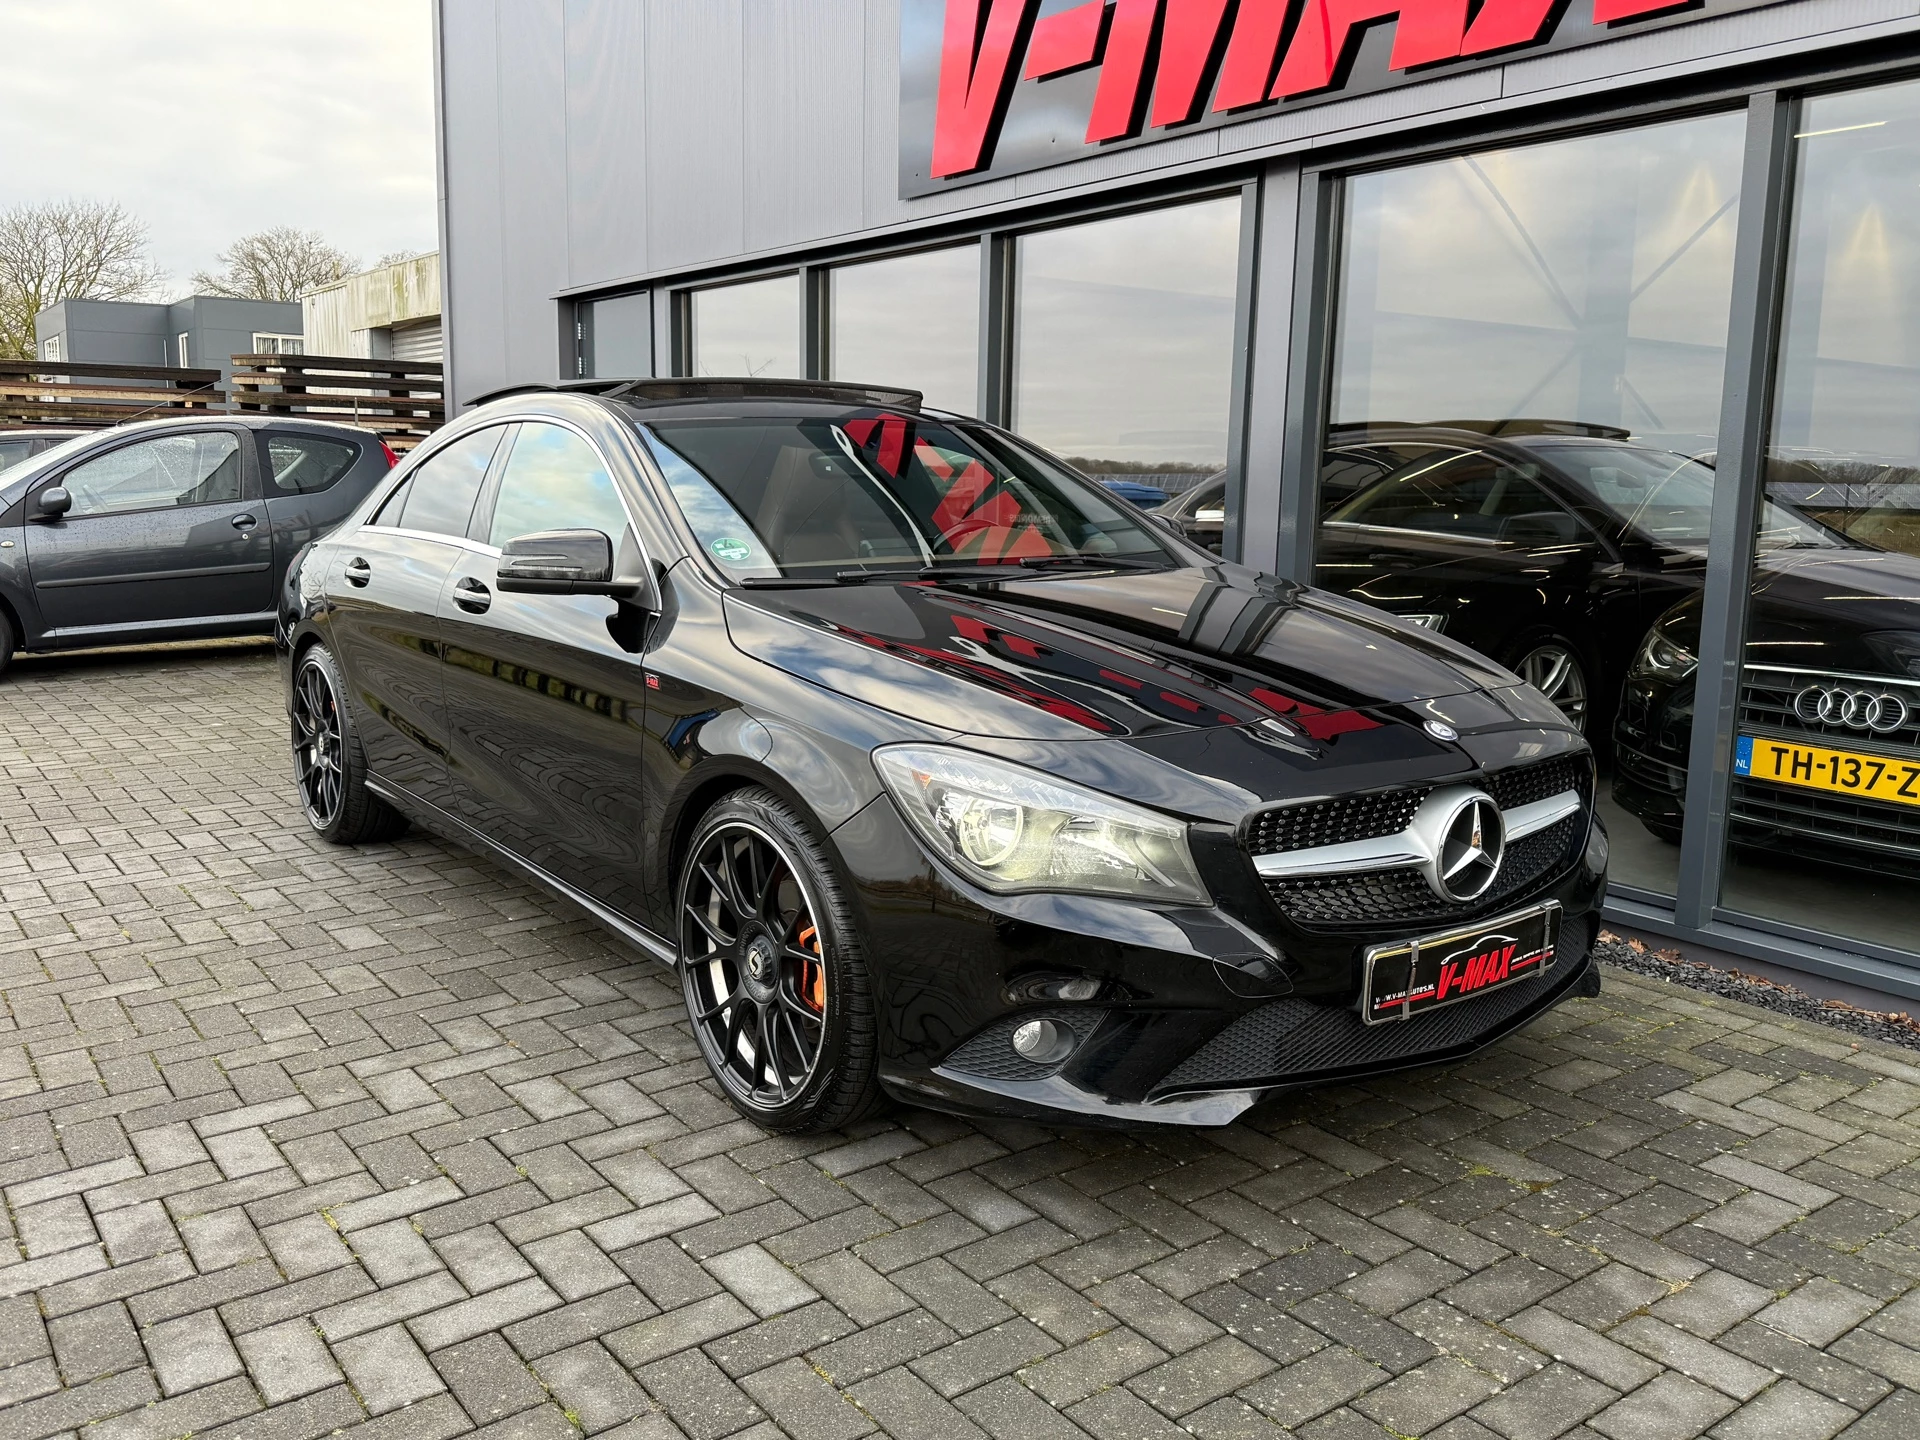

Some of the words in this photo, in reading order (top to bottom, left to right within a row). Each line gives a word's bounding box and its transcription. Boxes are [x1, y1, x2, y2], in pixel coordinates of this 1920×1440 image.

[1736, 759, 1748, 769] NL
[1771, 747, 1920, 798] TH-137-Z
[1437, 944, 1518, 1000] V-MAX
